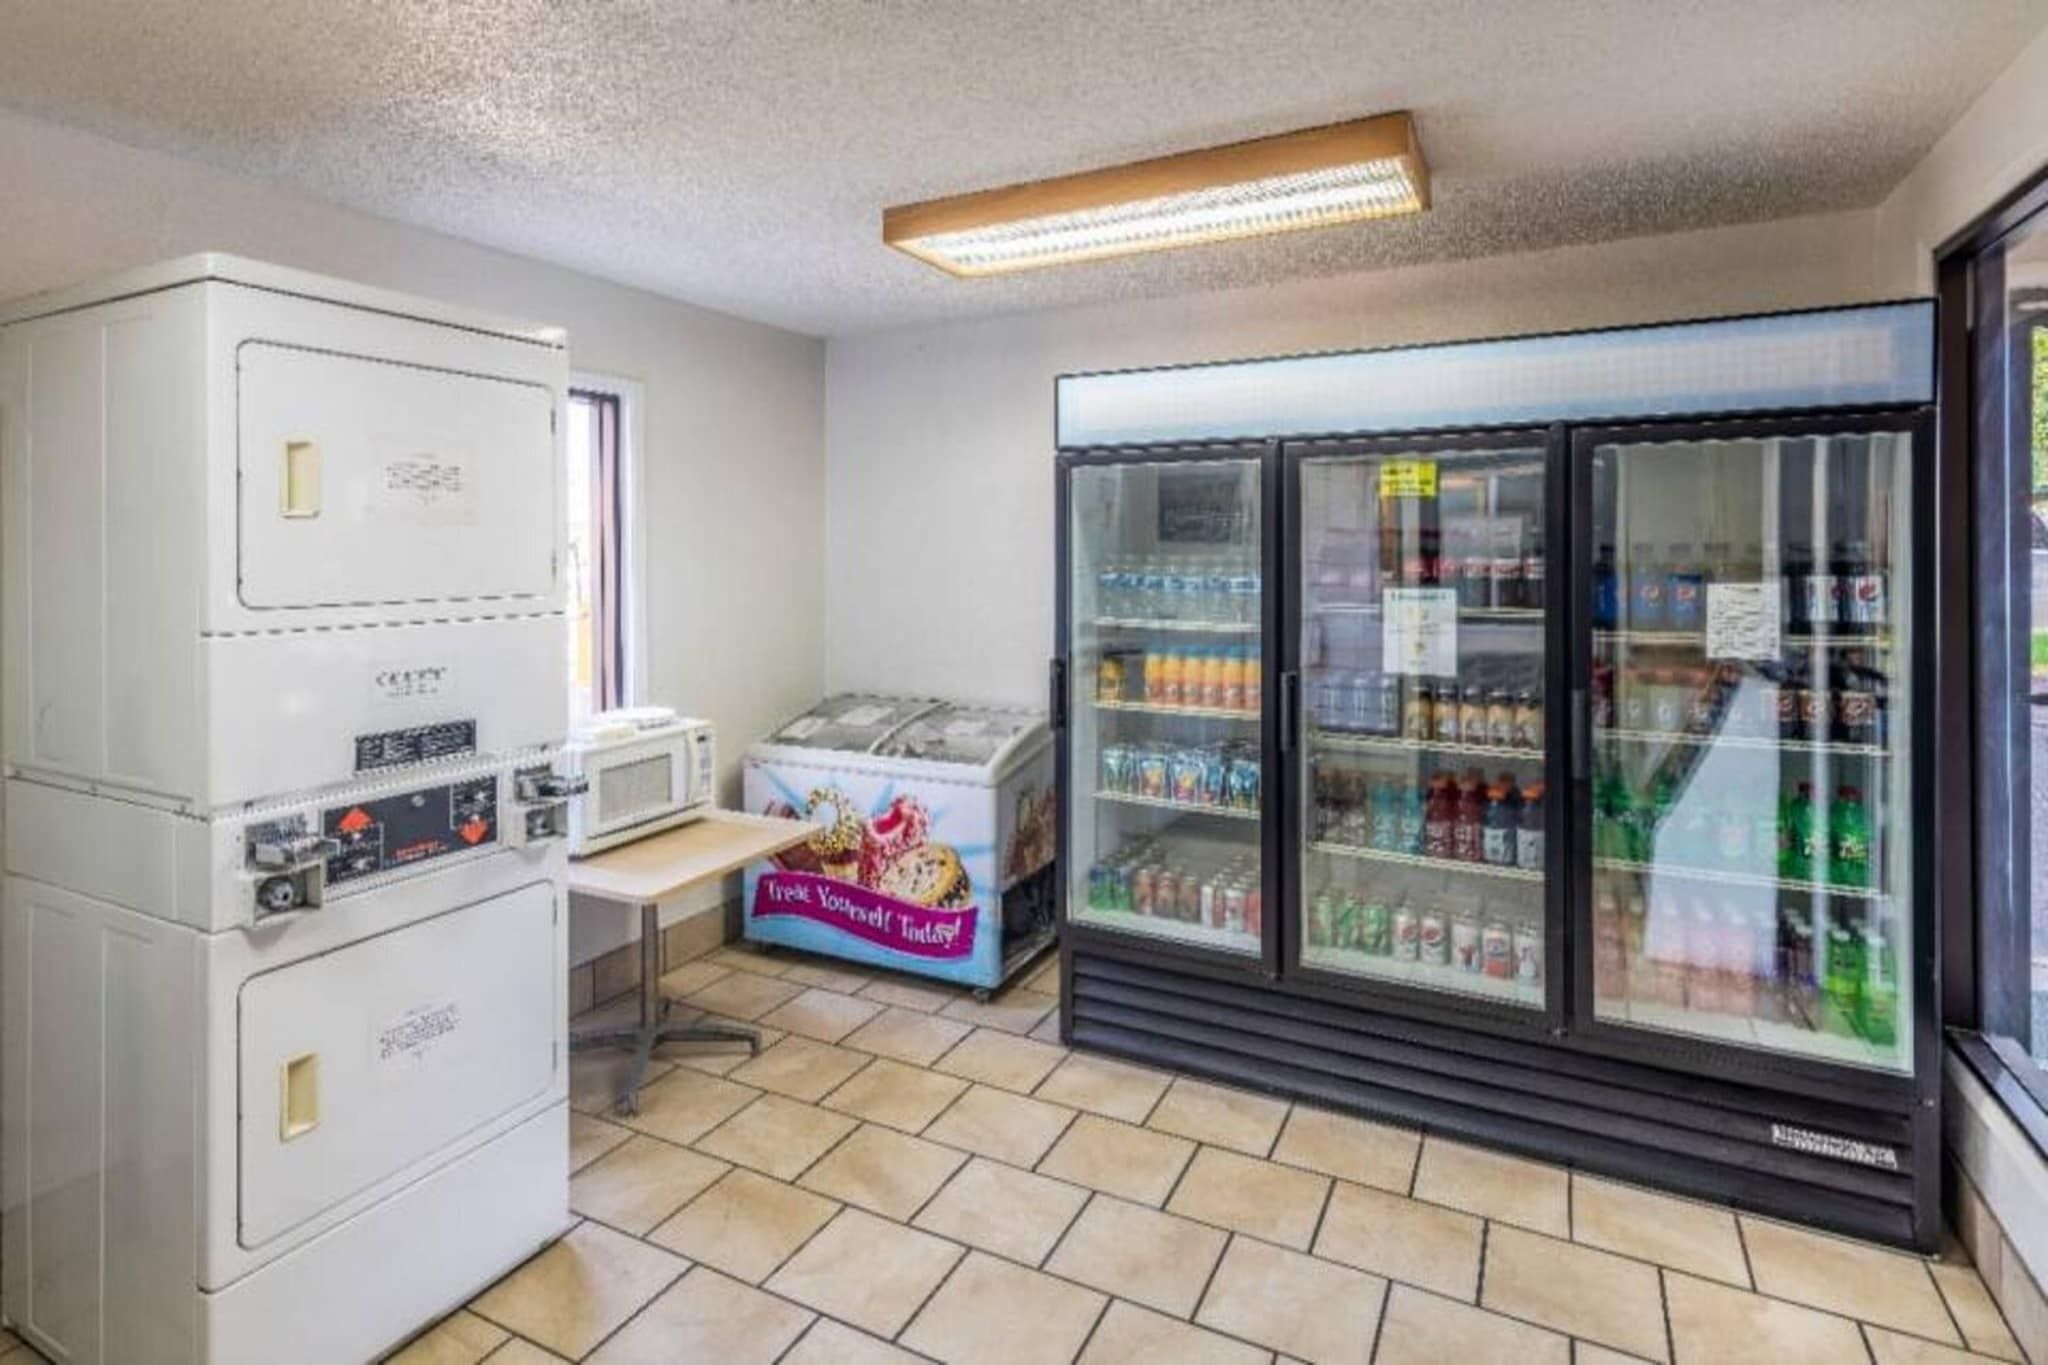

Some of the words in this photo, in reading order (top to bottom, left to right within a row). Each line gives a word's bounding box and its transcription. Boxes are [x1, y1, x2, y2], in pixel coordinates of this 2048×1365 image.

[766, 878, 812, 903] Treat
[817, 884, 892, 933] Yourself
[898, 914, 962, 949] Today!
